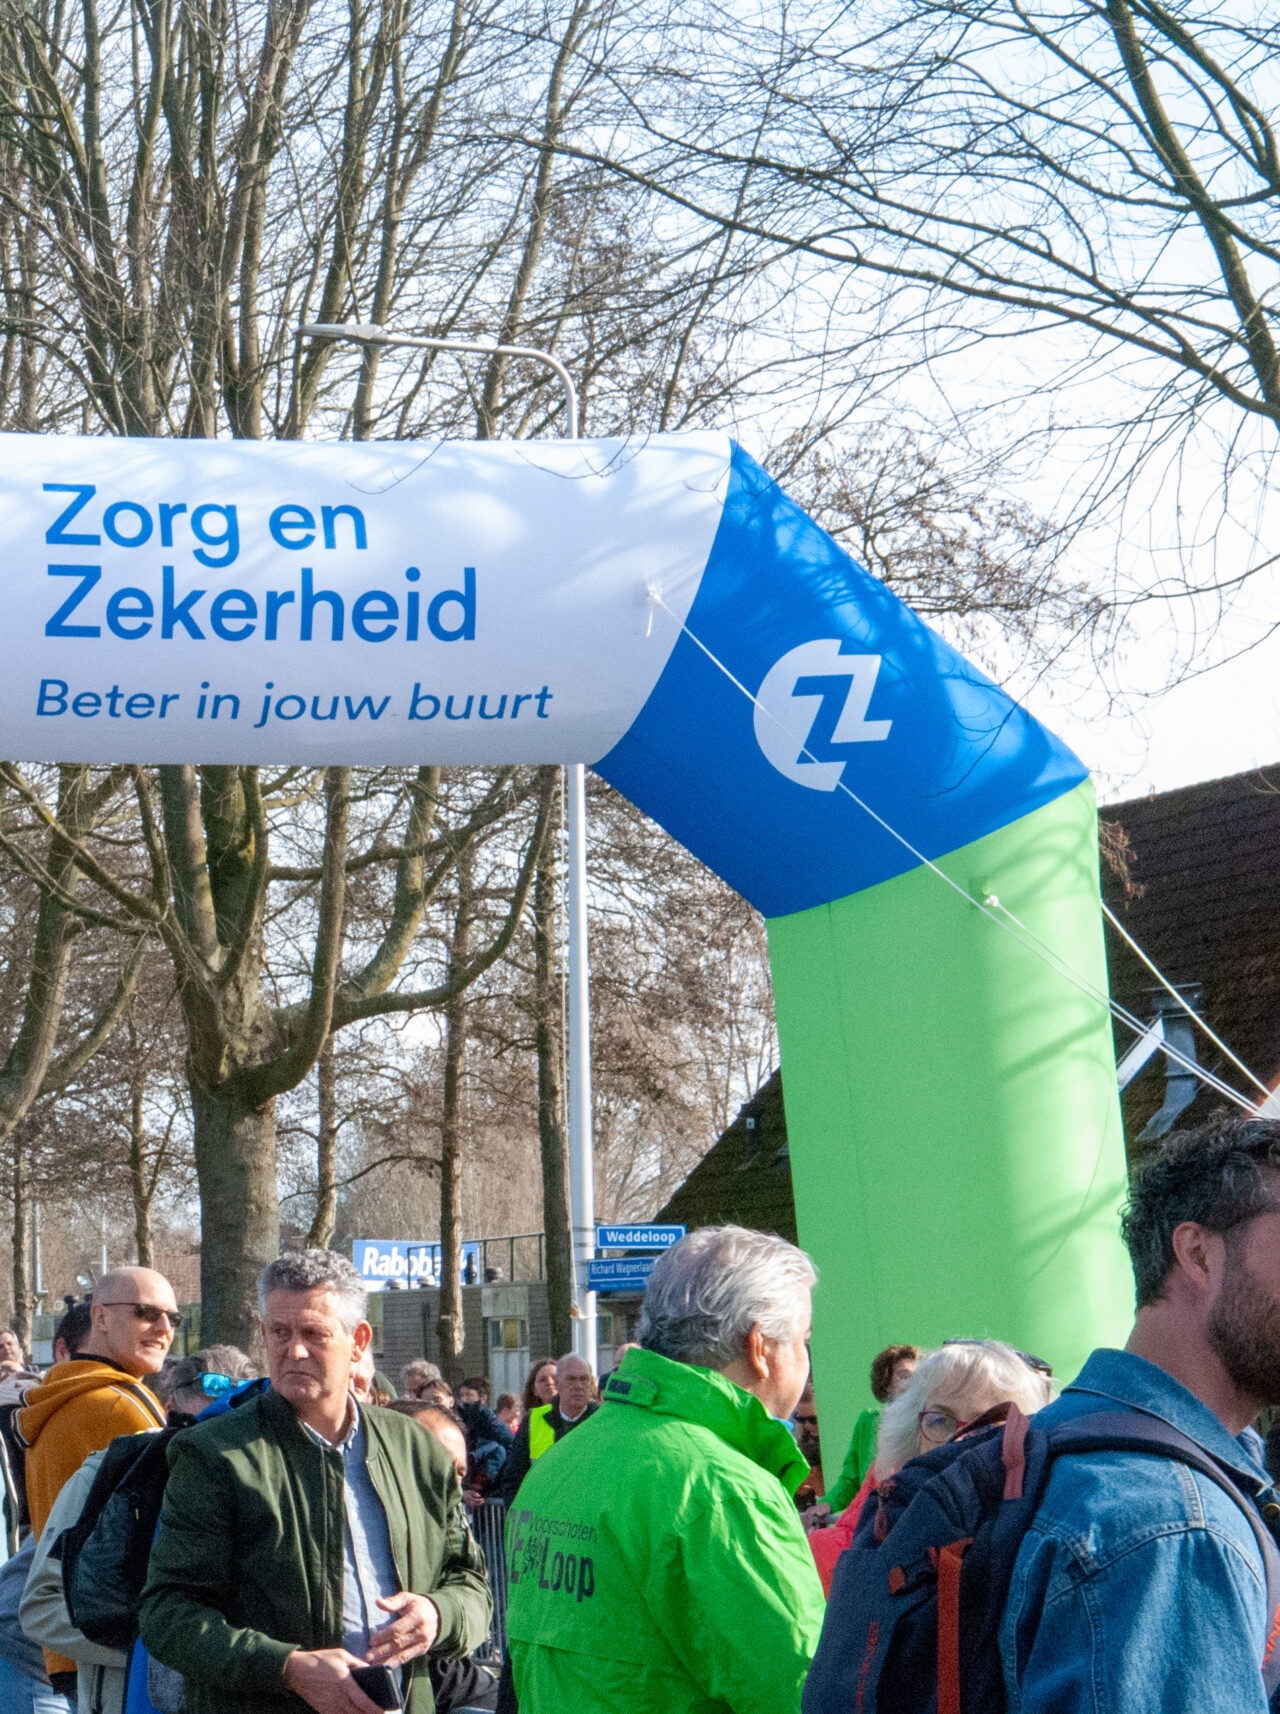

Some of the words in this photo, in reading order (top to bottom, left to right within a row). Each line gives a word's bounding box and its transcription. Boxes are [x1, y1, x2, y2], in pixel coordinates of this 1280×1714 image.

[42, 483, 240, 568] Zorg
[269, 503, 368, 551] en
[44, 563, 476, 643] Zekerheid
[35, 678, 180, 719] Beter
[196, 680, 241, 720] in
[253, 681, 392, 729] jouw
[407, 682, 554, 721] buurt
[362, 1246, 467, 1277] Rabob
[606, 1231, 676, 1245] Weddeloop
[591, 1263, 615, 1275] Richard
[538, 1537, 594, 1602] Loop
